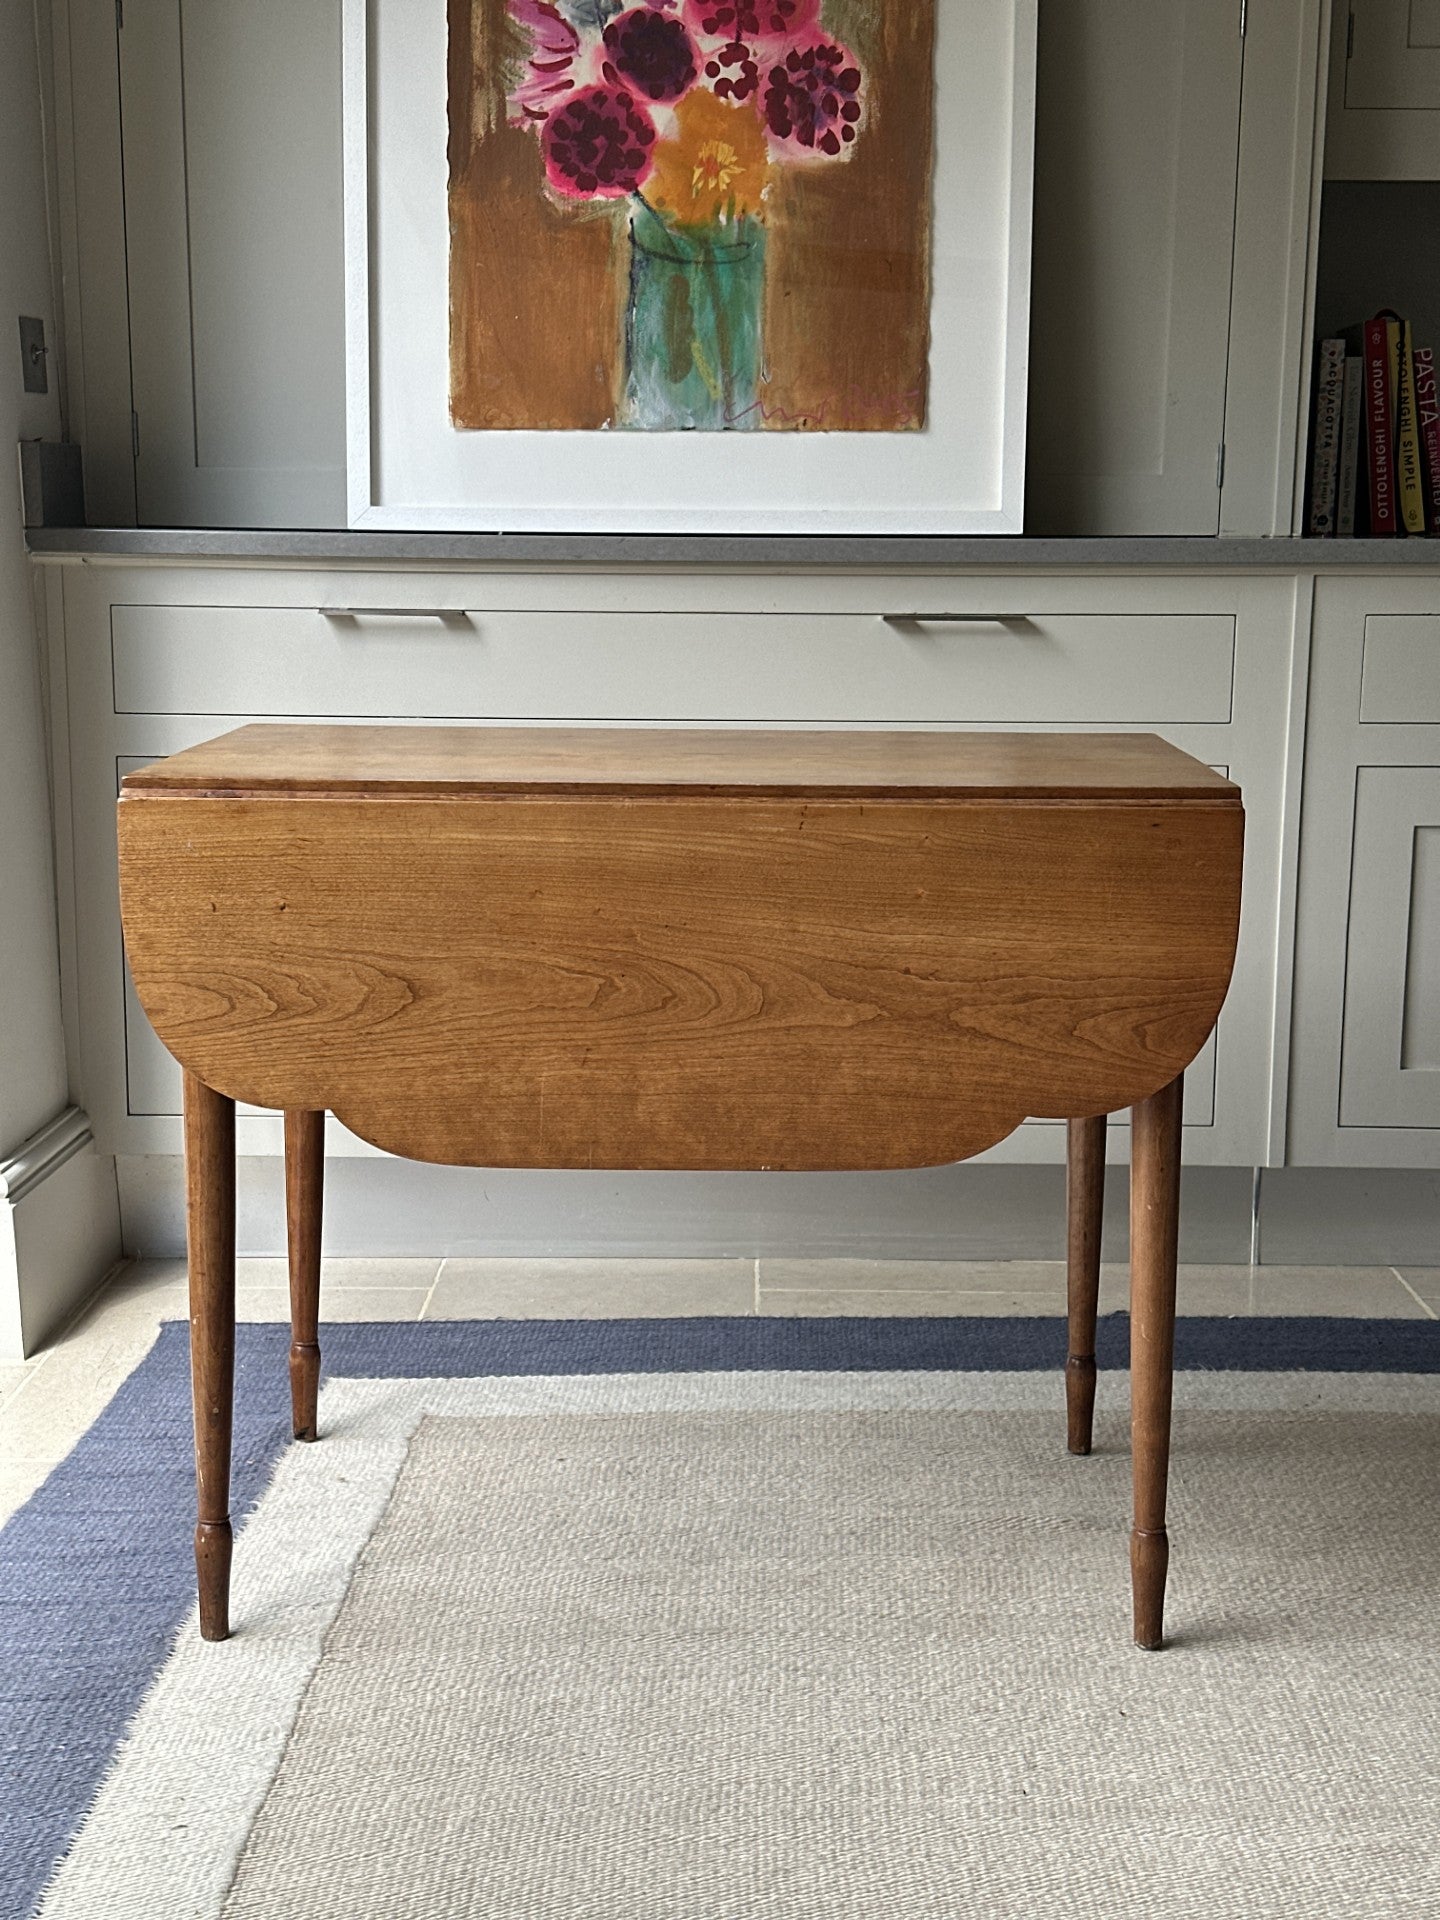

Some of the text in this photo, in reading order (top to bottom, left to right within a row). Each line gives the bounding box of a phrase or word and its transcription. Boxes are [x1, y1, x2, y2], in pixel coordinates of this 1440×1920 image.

[1323, 362, 1337, 448] ACQUACOTTA
[1372, 359, 1388, 519] OTTOLENGHI FLAVOUR
[1402, 440, 1416, 491] SIMPLE
[1415, 347, 1440, 506] PASTA REINVENTED
